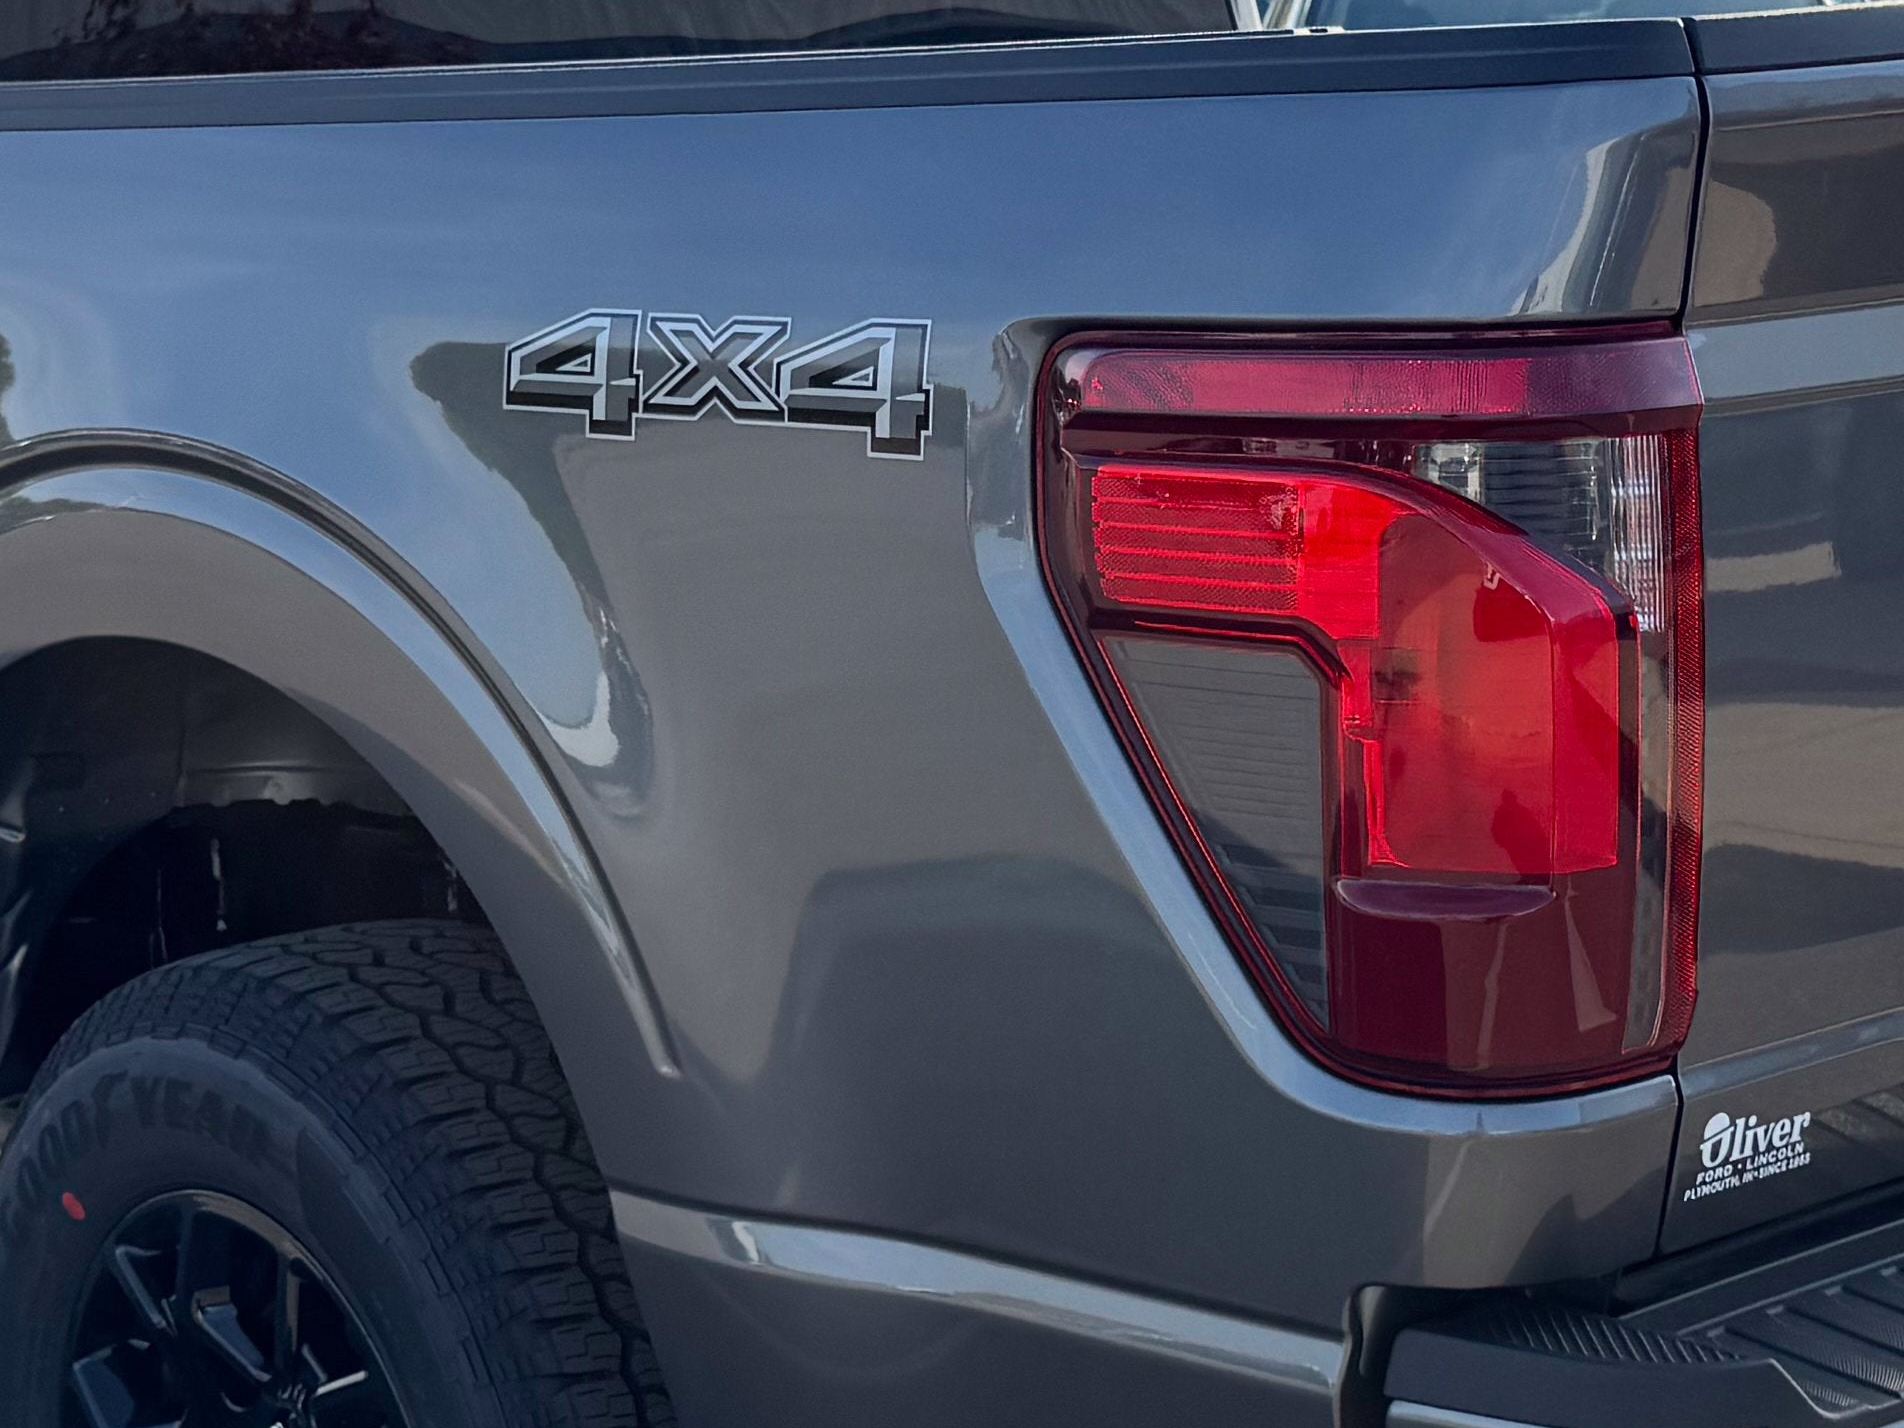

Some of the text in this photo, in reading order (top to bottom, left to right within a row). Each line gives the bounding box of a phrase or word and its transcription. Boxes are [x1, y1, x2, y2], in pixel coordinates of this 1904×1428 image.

[0, 1069, 274, 1244] GOODYEAR
[1696, 1142, 1804, 1186] FORD LINCOLN
[1699, 1112, 1811, 1168] Oliver
